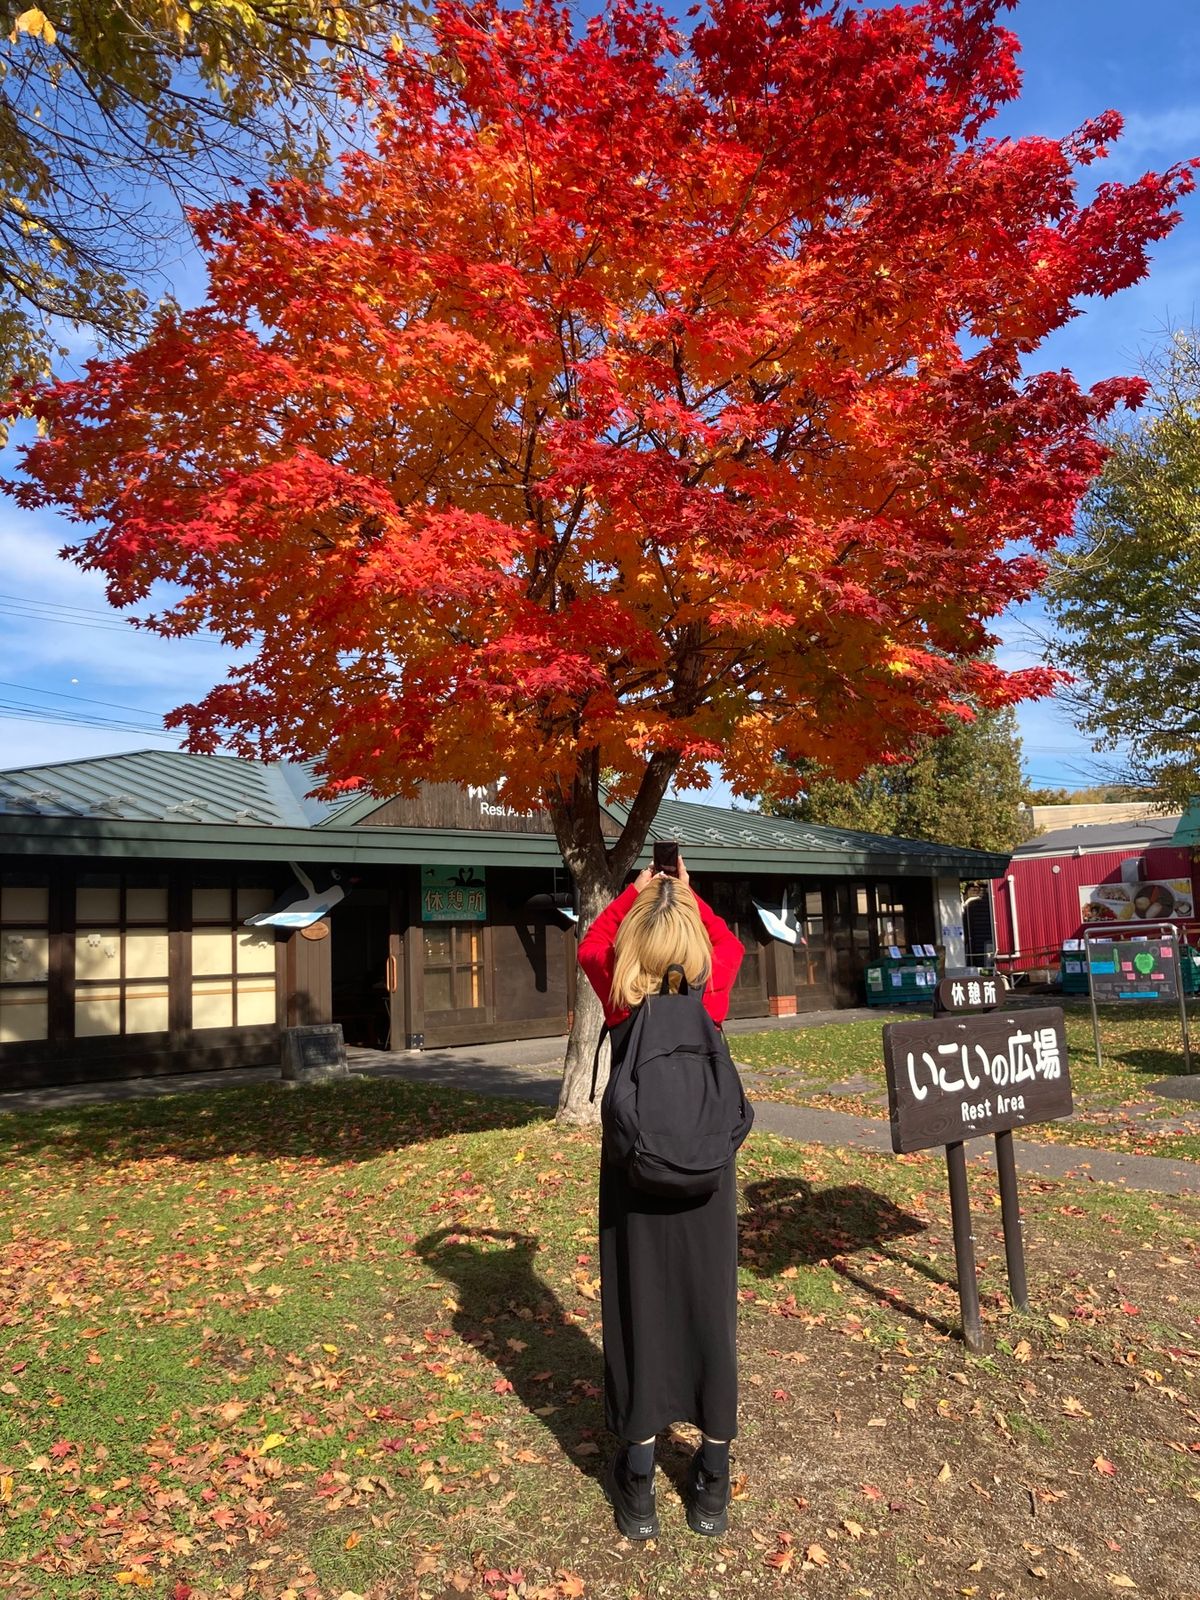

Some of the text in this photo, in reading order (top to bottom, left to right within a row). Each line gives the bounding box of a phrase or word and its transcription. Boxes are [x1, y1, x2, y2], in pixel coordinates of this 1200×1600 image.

[425, 890, 483, 912] 休憩所
[951, 981, 996, 1006] 休憩所
[907, 1027, 1061, 1101] いこいの広場
[961, 1094, 1025, 1122] Rest Area
